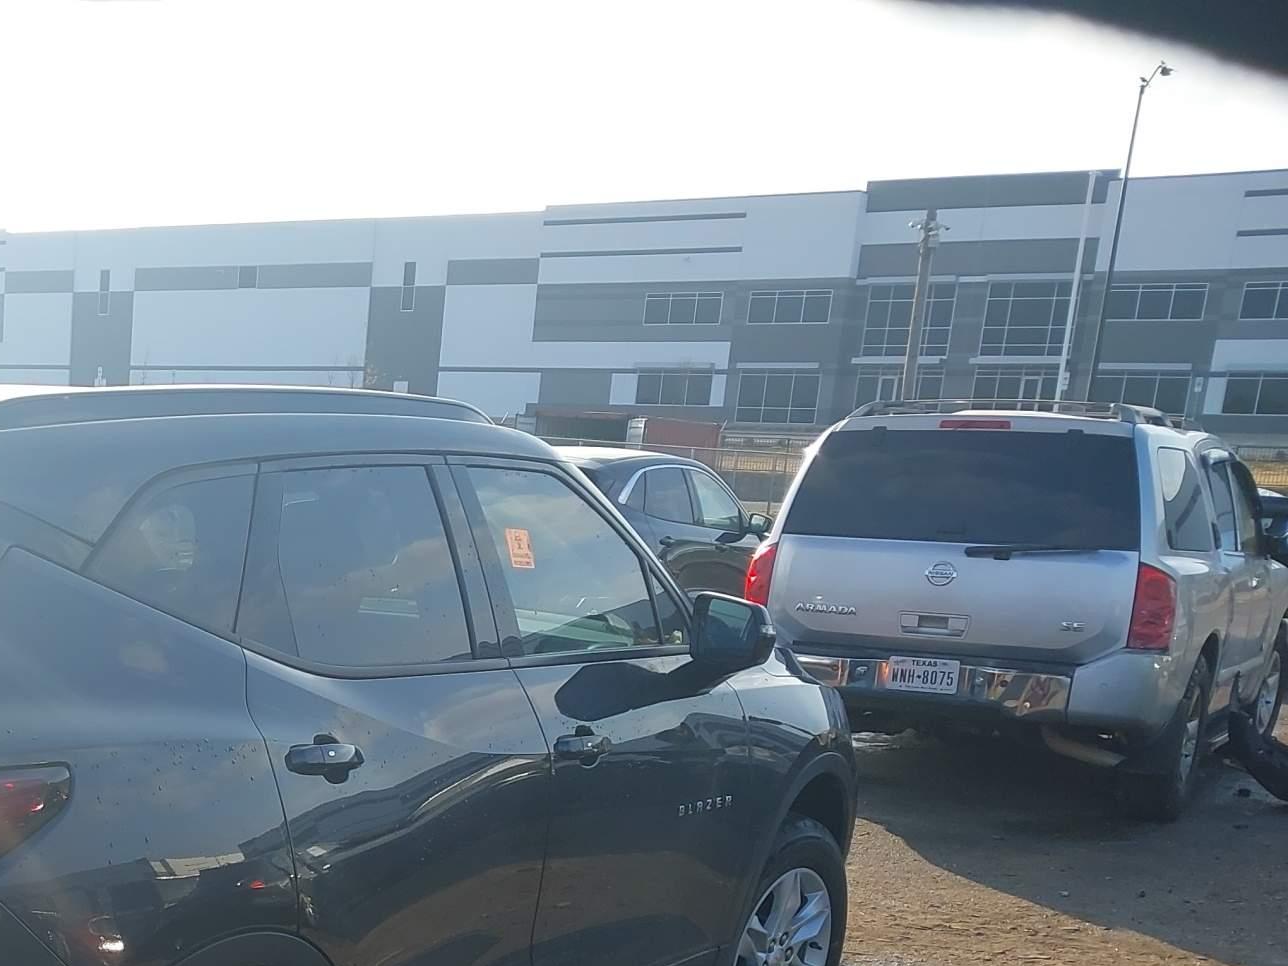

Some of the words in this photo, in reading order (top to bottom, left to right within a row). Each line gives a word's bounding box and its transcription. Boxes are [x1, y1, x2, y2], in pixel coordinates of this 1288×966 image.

[927, 569, 954, 577] NISSAN
[794, 603, 857, 616] ARMADA
[1058, 621, 1086, 631] SE
[911, 659, 938, 668] TEXAS
[678, 795, 733, 817] BLAZER
